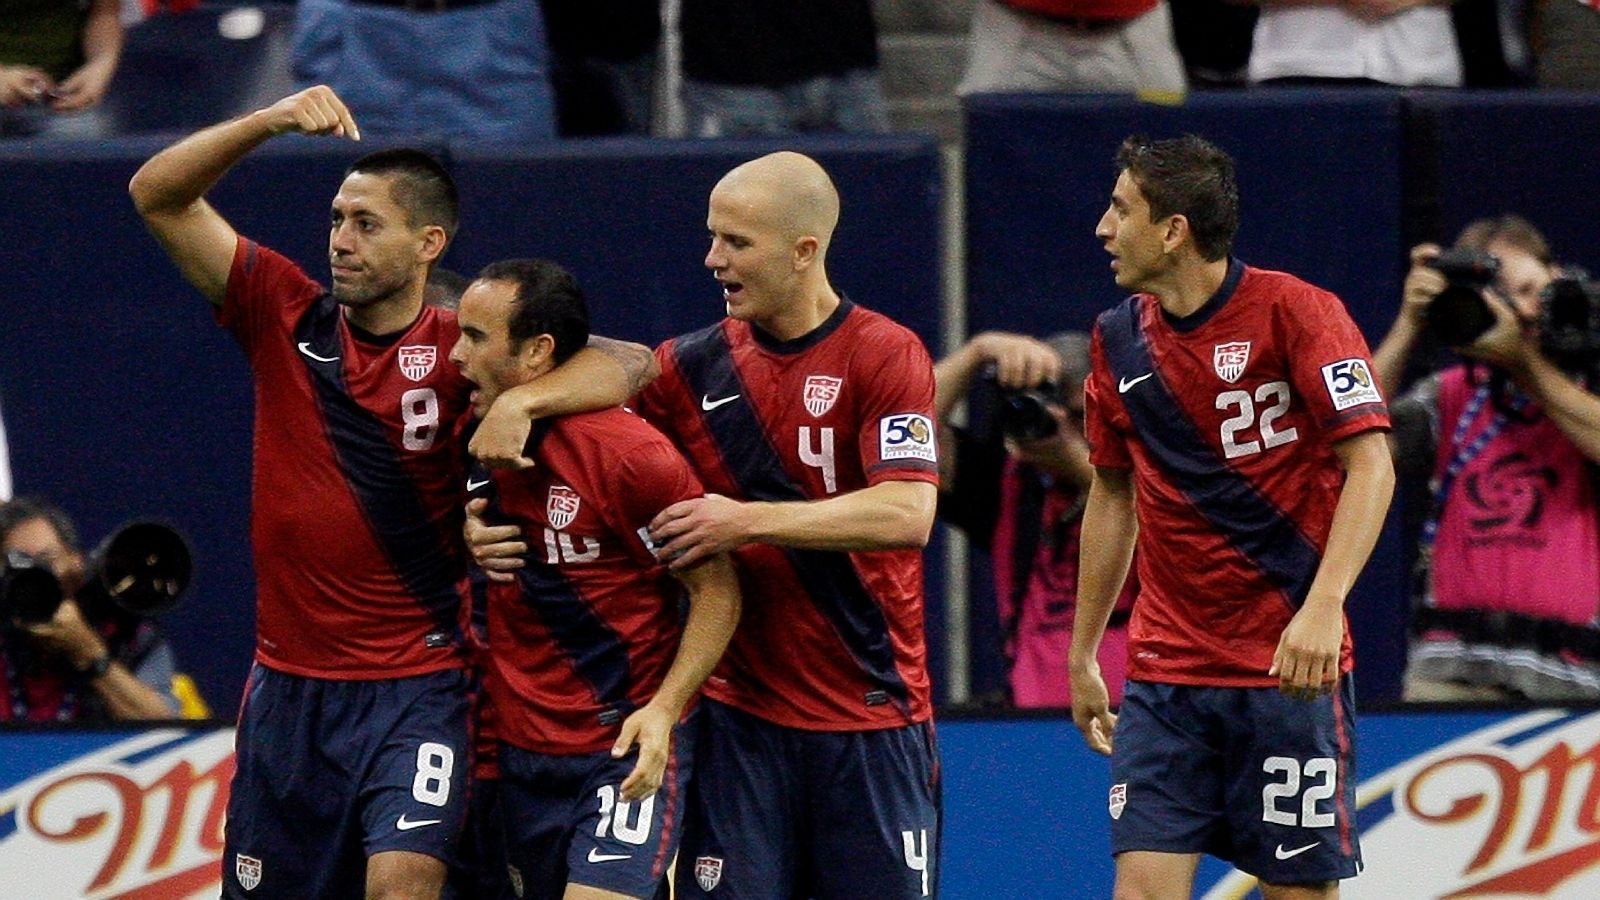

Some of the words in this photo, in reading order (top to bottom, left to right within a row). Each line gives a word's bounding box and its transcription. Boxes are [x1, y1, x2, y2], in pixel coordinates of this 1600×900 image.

[402, 388, 439, 451] 8
[1215, 381, 1298, 459] 22
[798, 426, 837, 493] 4
[412, 742, 453, 807] 8
[1262, 756, 1337, 828] 22
[595, 785, 655, 845] 10
[902, 829, 929, 896] 4
